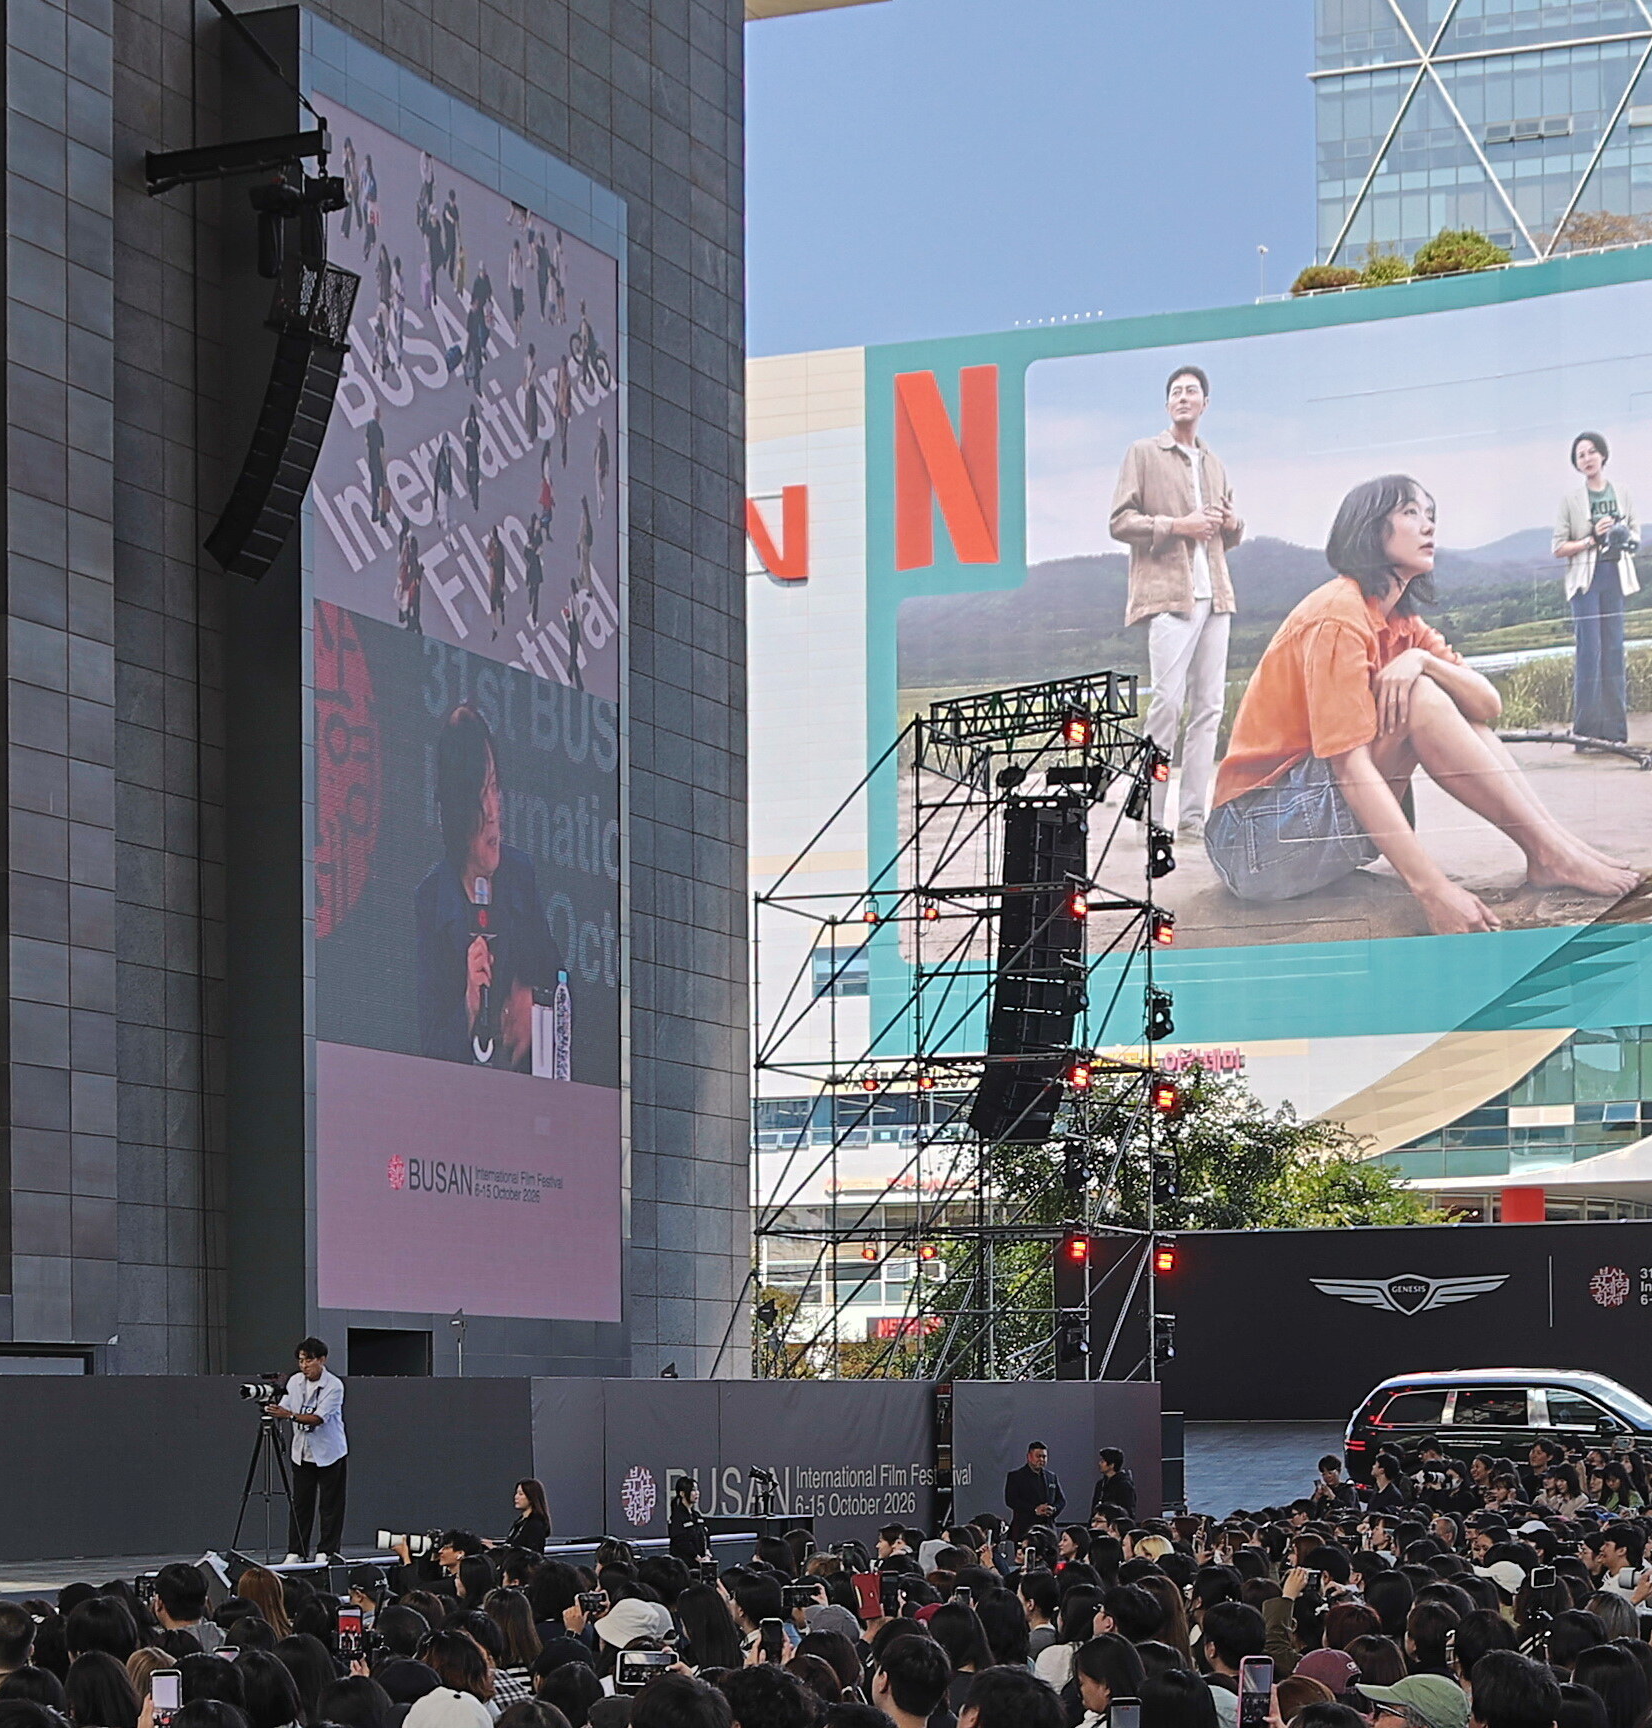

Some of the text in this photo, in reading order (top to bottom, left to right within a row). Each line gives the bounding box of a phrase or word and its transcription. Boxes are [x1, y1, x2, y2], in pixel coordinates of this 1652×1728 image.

[894, 363, 999, 572] N
[409, 1158, 472, 1196] BUSAN
[1392, 1285, 1427, 1294] GENESIS
[796, 1465, 878, 1490] International
[880, 1464, 908, 1487] Film
[795, 1492, 916, 1517] 6-15 October 2026
